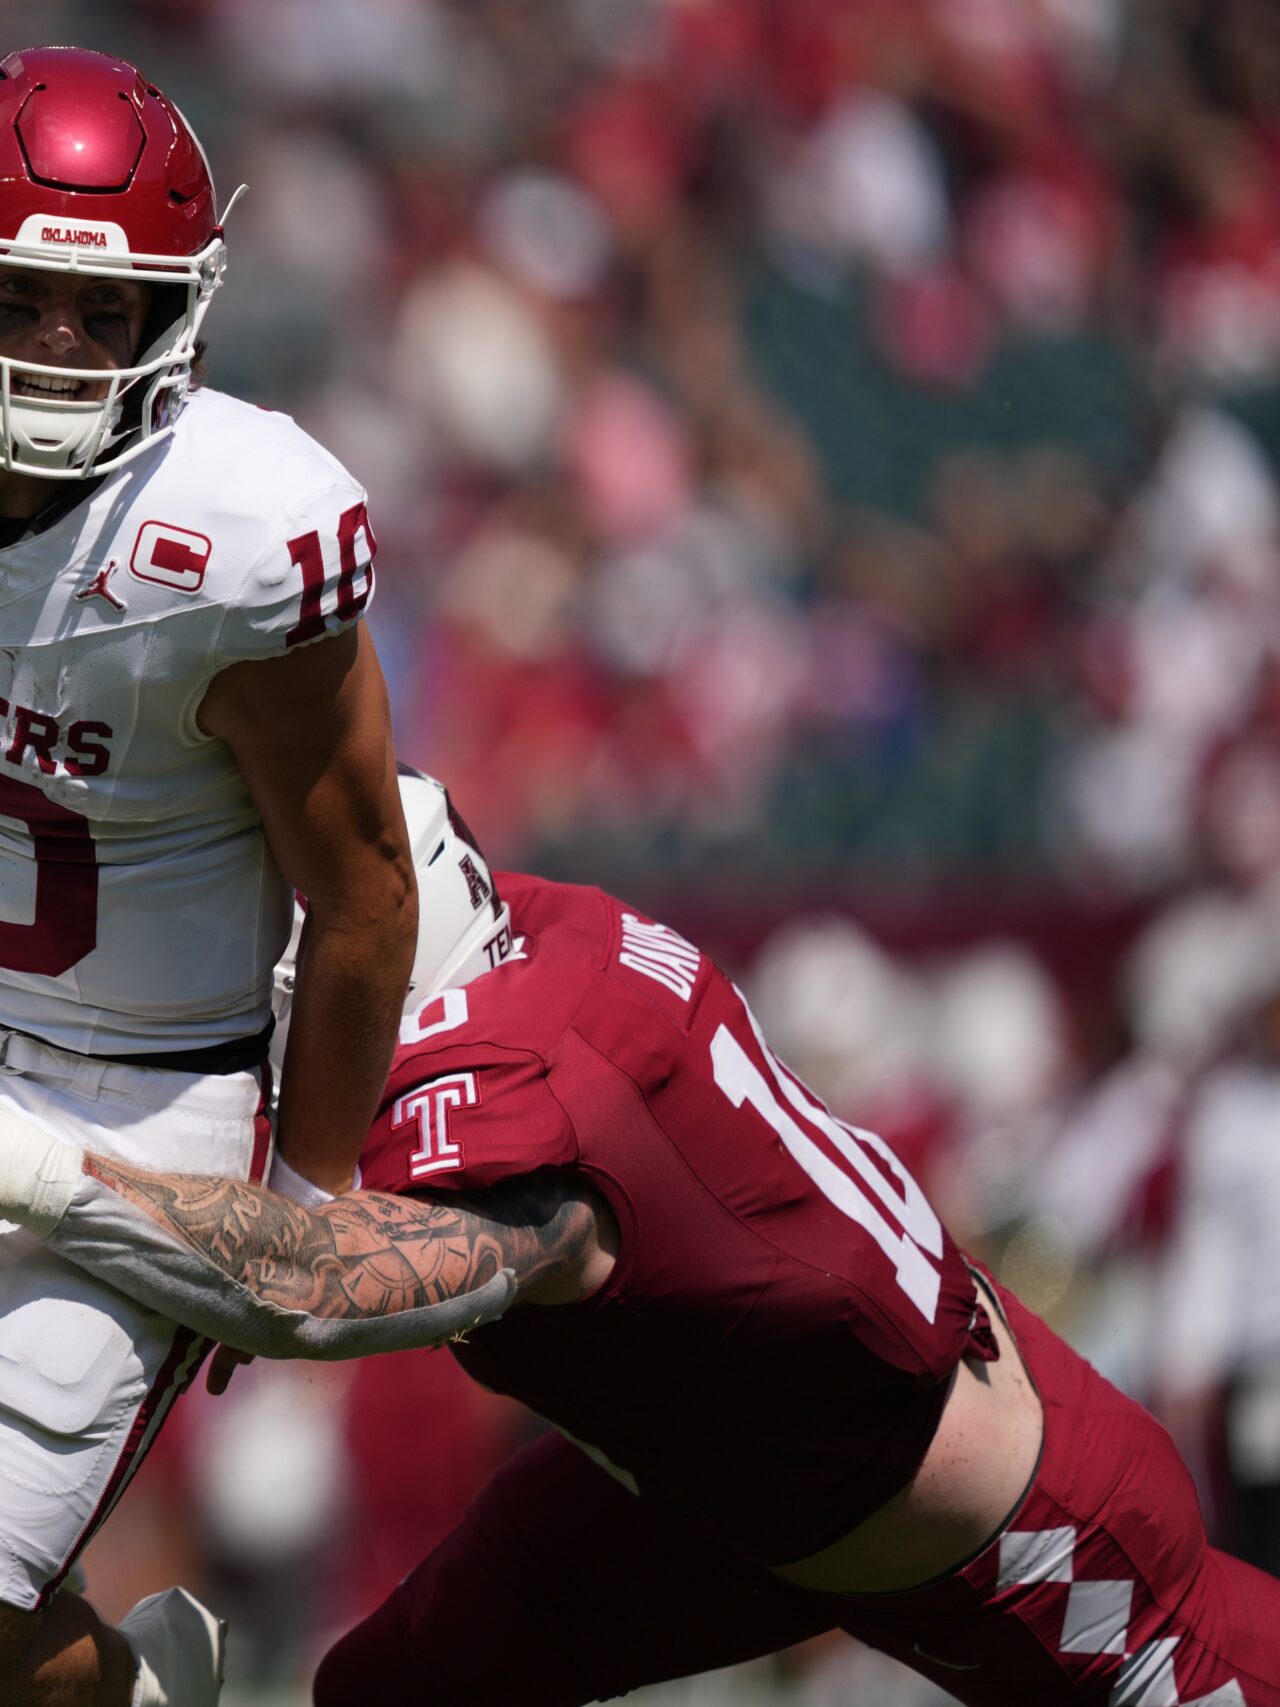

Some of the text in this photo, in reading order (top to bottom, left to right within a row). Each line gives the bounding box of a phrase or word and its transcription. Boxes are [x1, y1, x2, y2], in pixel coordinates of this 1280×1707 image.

[41, 227, 108, 247] OKLAHOMA
[131, 520, 212, 592] C
[286, 502, 377, 648] 10
[393, 1071, 481, 1180] T
[709, 981, 944, 1325] 10
